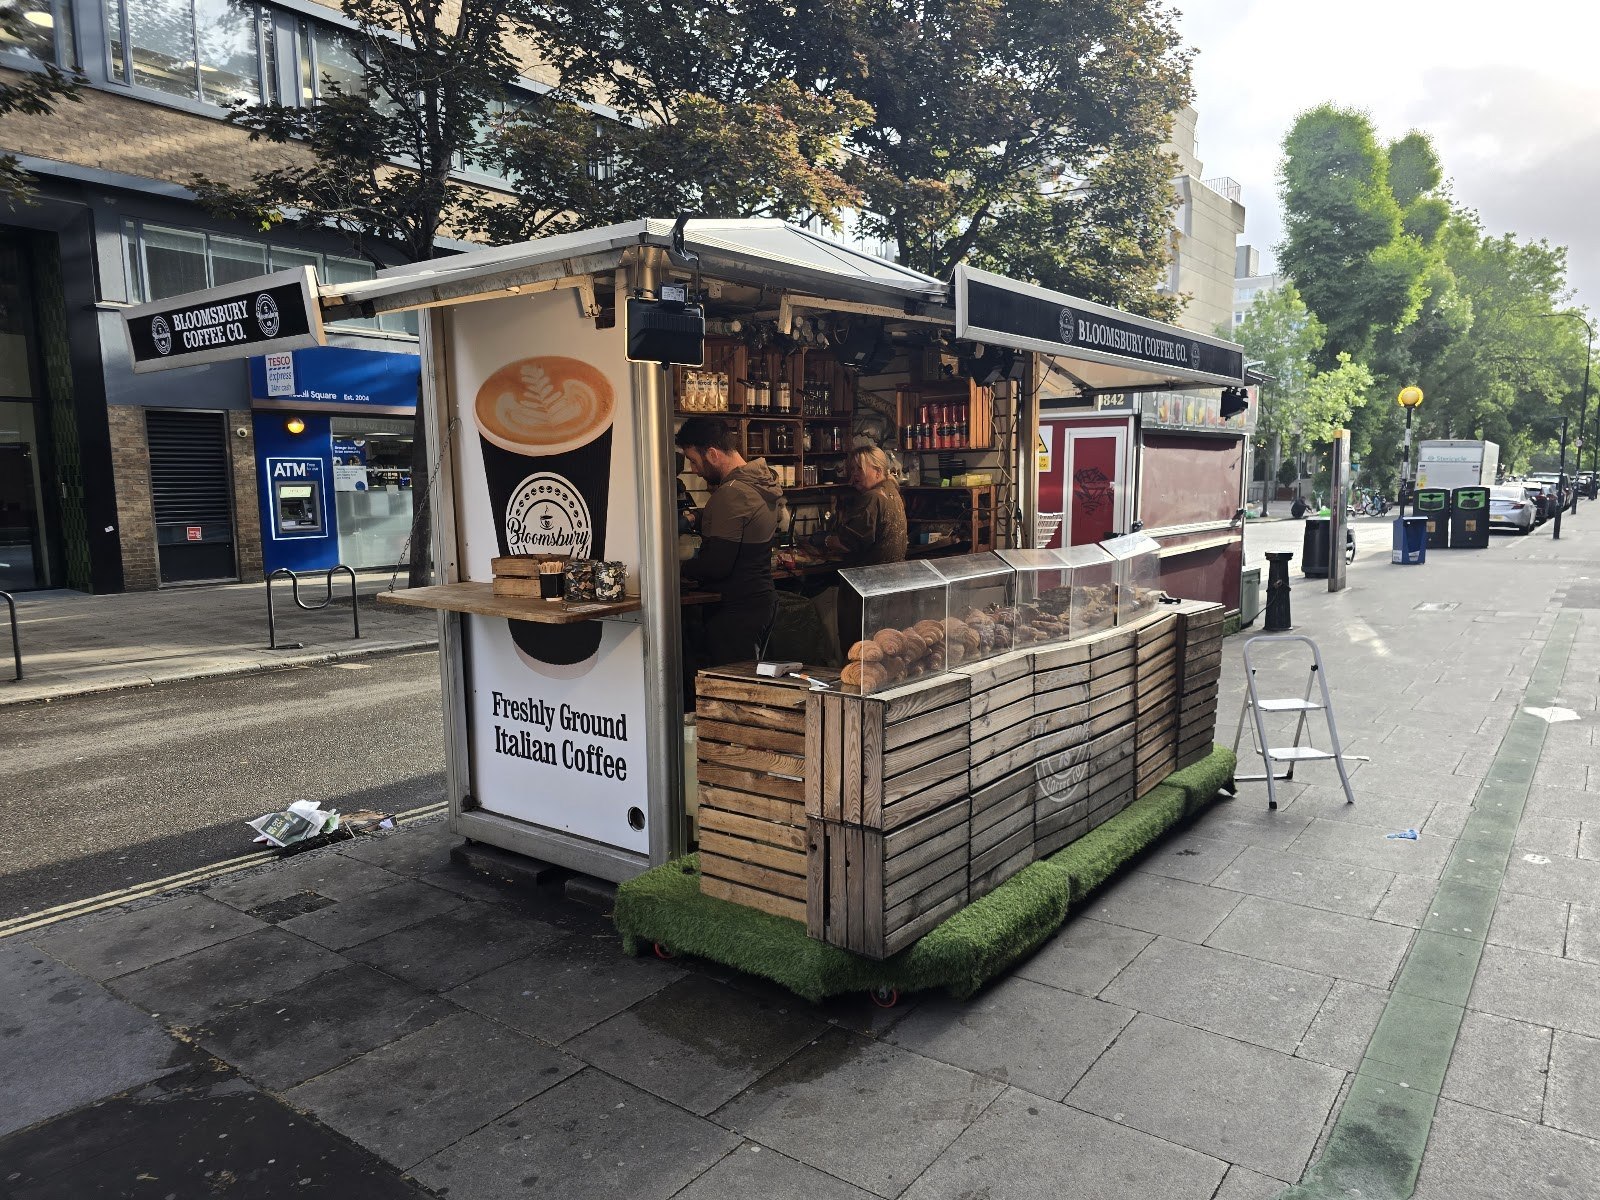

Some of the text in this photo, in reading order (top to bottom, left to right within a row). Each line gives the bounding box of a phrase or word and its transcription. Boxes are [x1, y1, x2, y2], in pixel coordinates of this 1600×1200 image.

[172, 300, 248, 331] BLOOMSBURY
[183, 326, 225, 348] COFFEE
[226, 322, 247, 341] CO.
[1078, 319, 1143, 353] BLOOMSBURY
[1144, 336, 1175, 360] COFFEE
[1175, 343, 1188, 363] CO.
[268, 355, 291, 367] TESCO
[269, 371, 292, 384] express
[310, 390, 337, 401] Square
[274, 462, 307, 477] ATM
[506, 516, 590, 552] Bloomsbury
[492, 691, 628, 742] Freshly Ground
[494, 725, 627, 781] Italian Coffee
